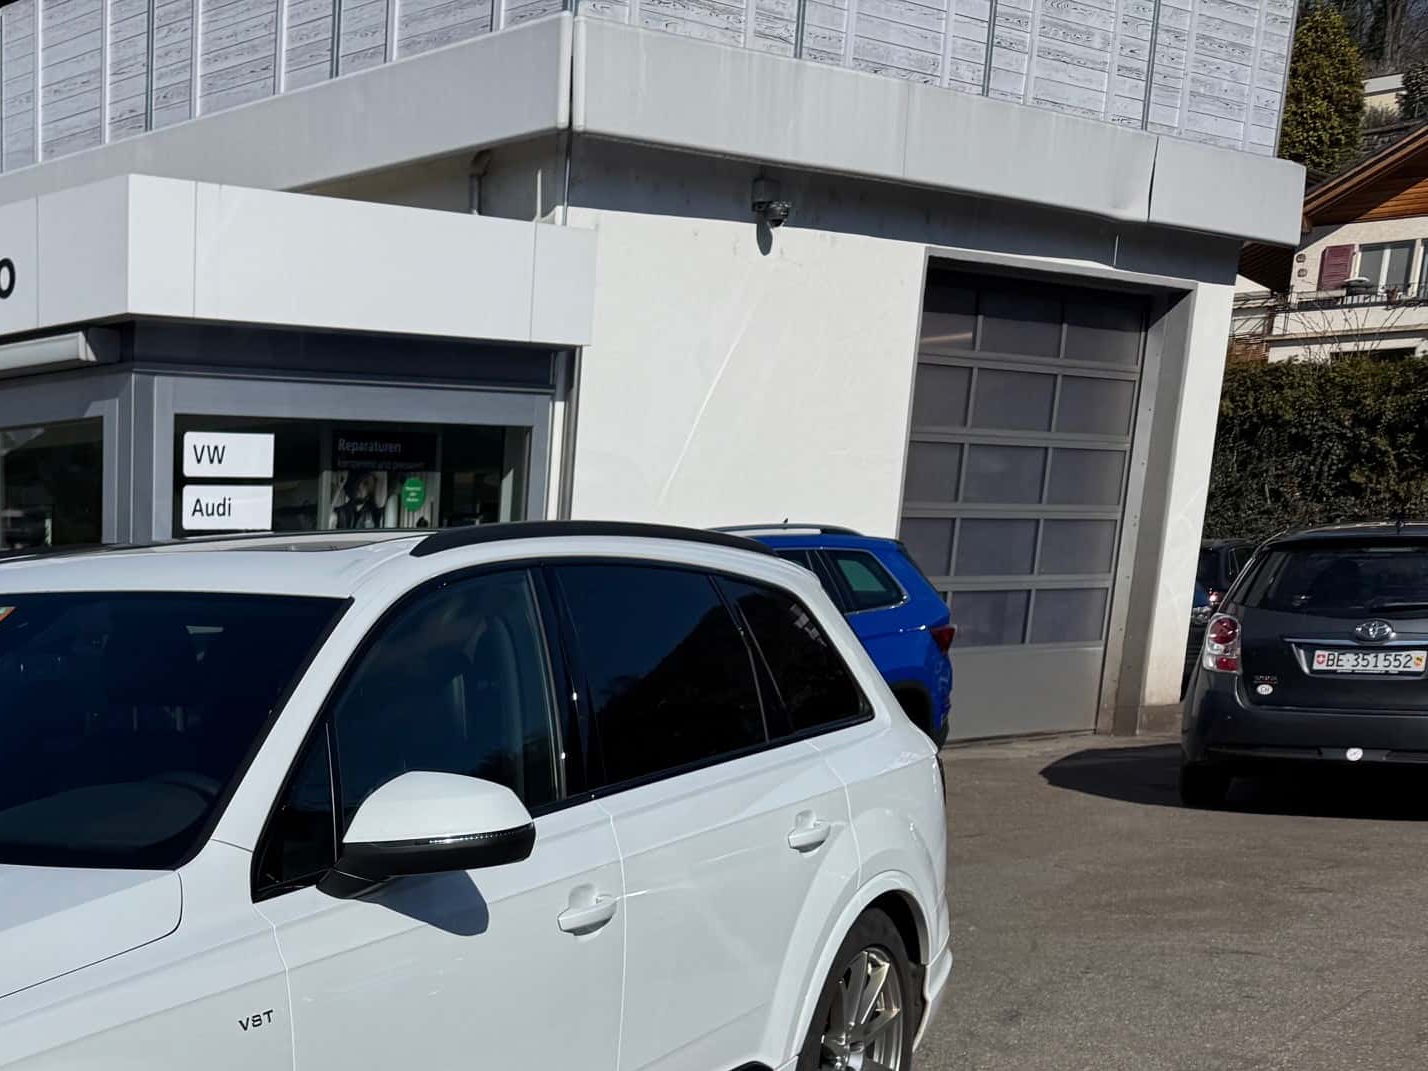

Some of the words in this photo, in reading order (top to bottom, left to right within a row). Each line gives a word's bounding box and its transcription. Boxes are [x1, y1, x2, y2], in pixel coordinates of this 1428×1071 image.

[193, 444, 225, 465] VW
[338, 438, 402, 455] Reparaturen
[191, 496, 232, 517] Audi
[1326, 653, 1344, 667] BE
